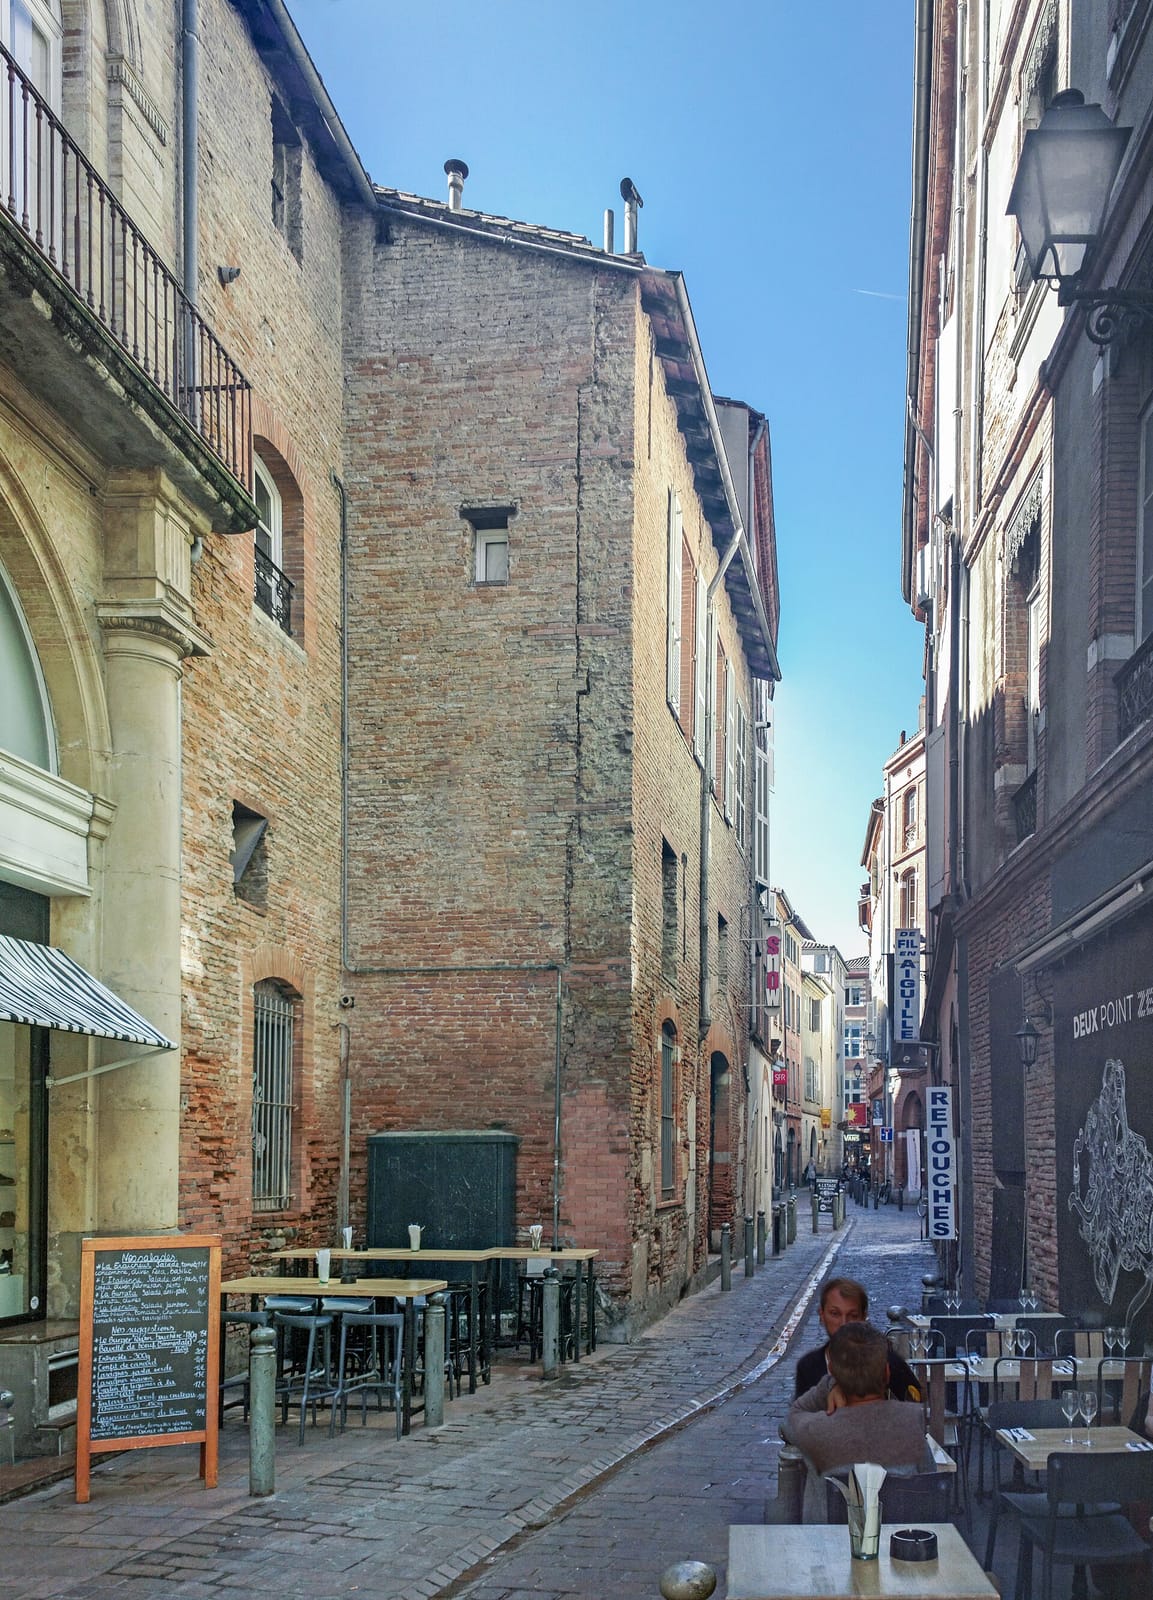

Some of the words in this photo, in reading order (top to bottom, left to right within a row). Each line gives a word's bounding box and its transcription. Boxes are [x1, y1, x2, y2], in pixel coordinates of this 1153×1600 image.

[898, 939, 918, 949] FIL
[900, 959, 916, 1040] AIGUILLE
[1073, 1007, 1099, 1040] DEUX
[1100, 994, 1134, 1030] POINT
[774, 1073, 786, 1082] SFR
[843, 1133, 860, 1142] VANS
[930, 1091, 951, 1236] RETOUCHES
[126, 1324, 176, 1337] suggestions
